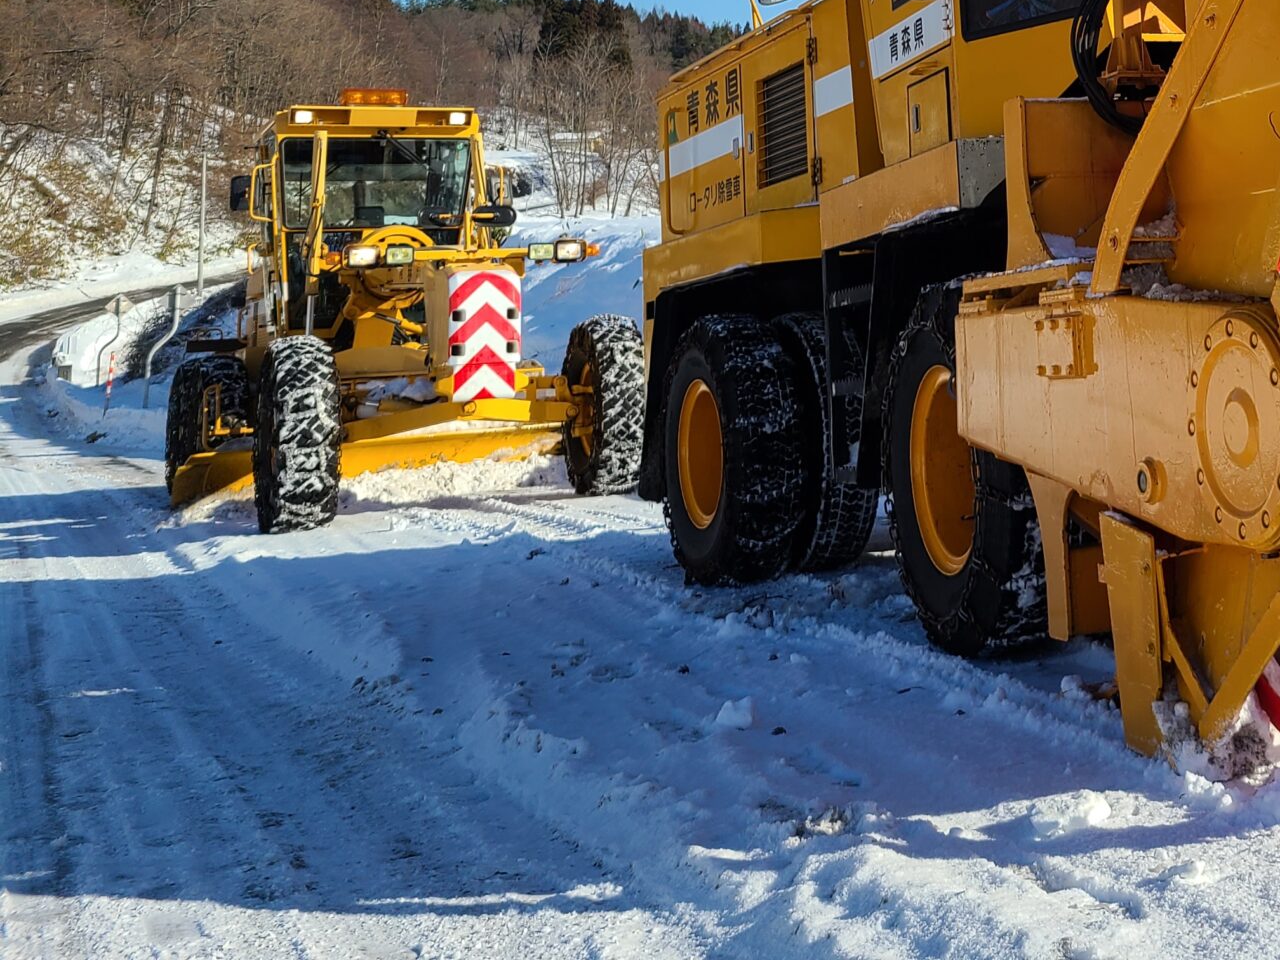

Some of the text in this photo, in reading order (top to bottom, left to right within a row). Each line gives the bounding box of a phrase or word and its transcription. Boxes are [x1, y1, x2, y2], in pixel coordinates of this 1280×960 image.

[889, 17, 924, 63] 青森県
[686, 68, 740, 136] 青森県
[689, 175, 741, 213] ロータリ除雪車
